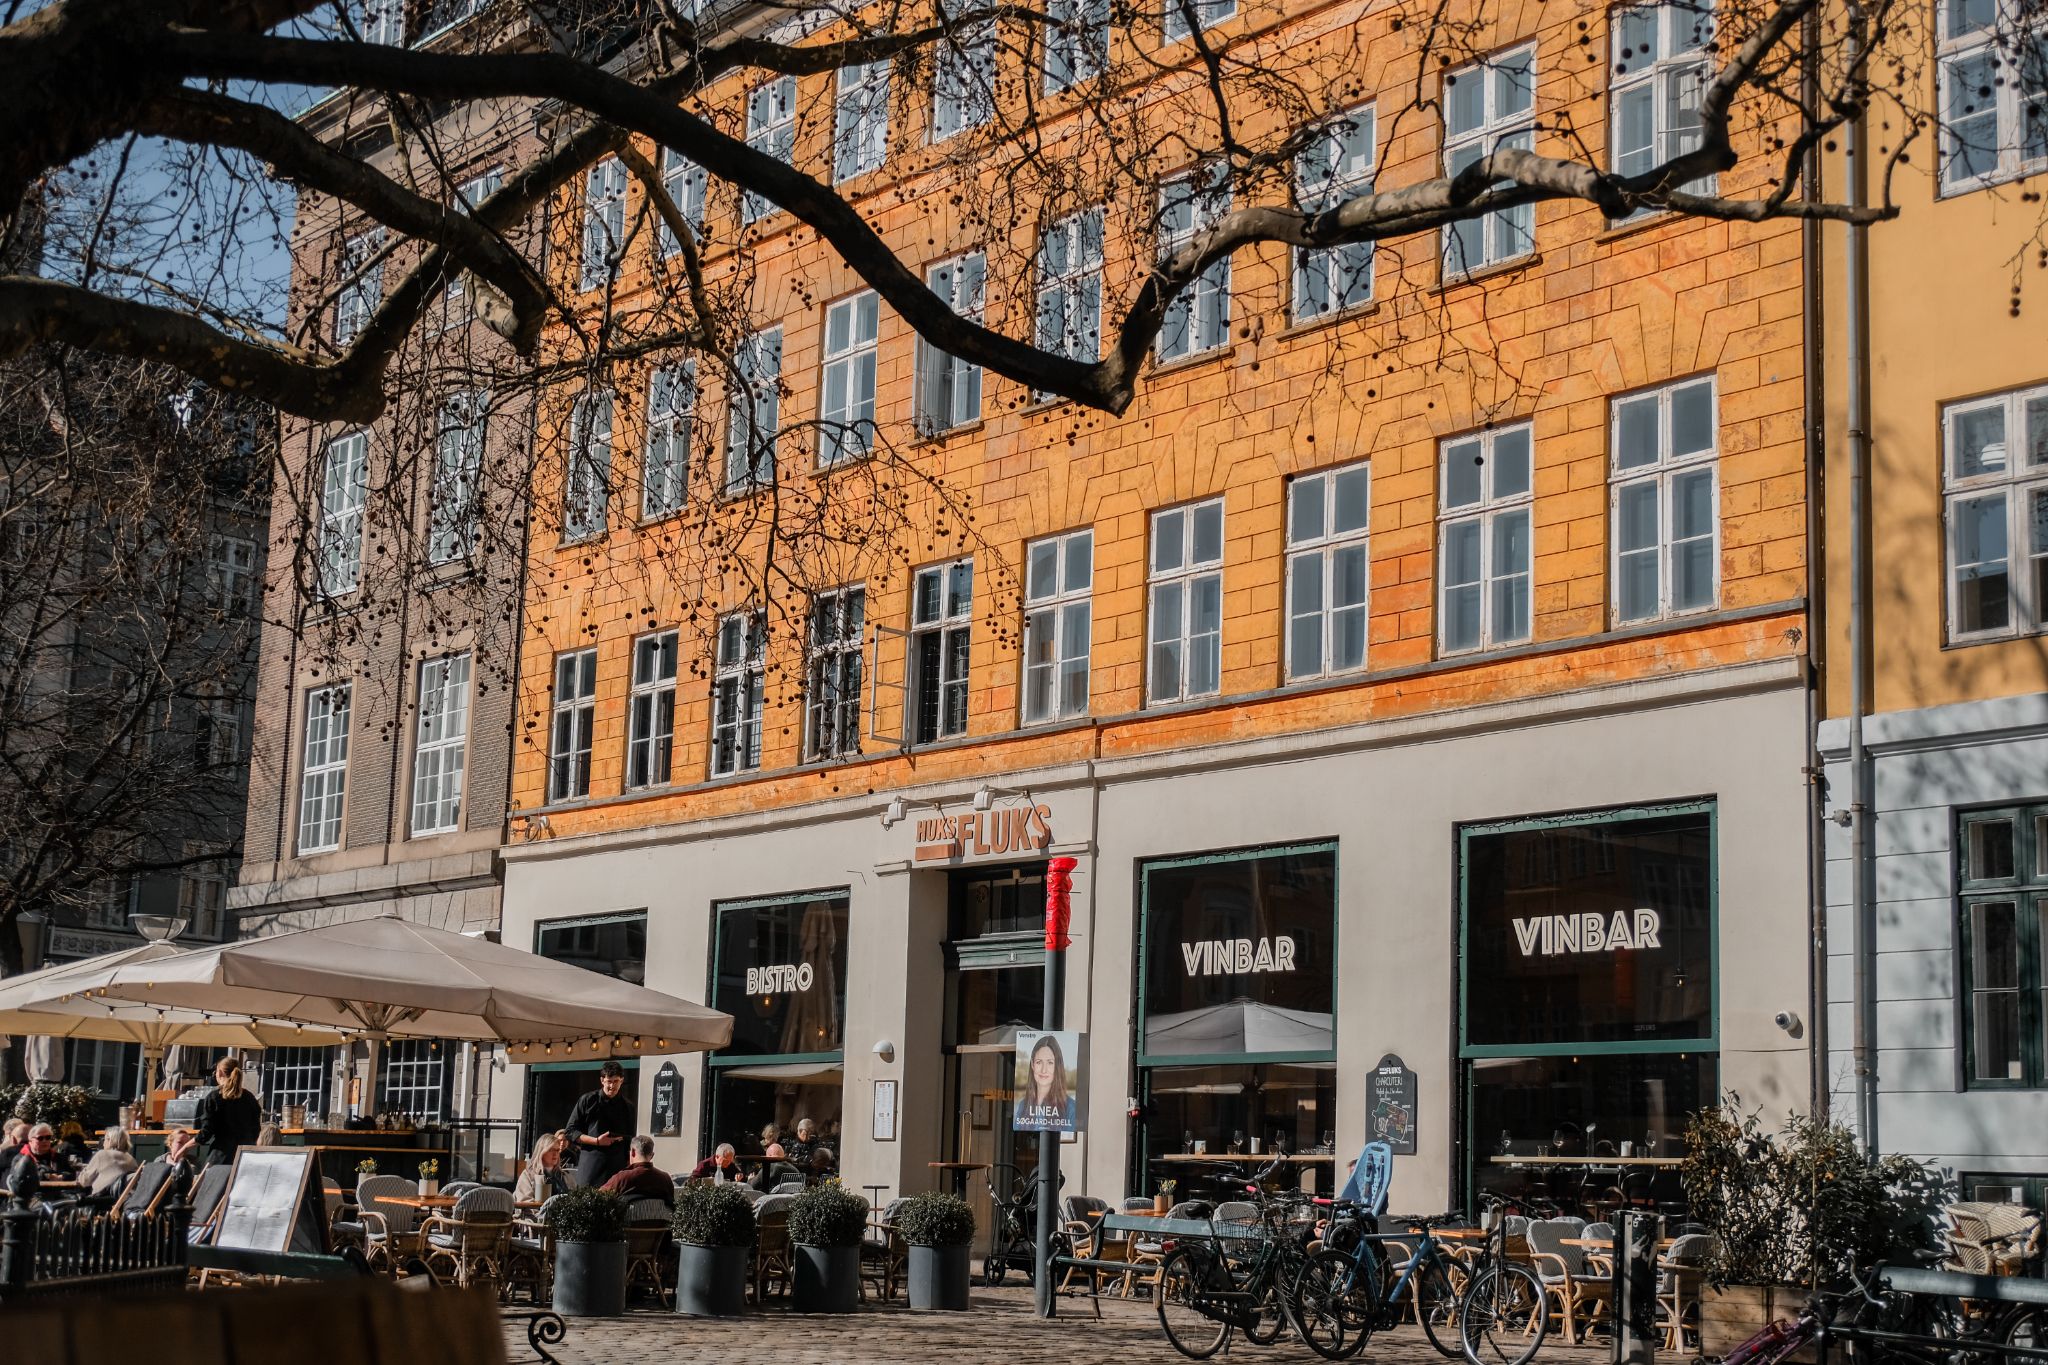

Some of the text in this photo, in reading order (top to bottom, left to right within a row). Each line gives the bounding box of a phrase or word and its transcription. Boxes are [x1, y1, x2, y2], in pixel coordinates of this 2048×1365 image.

[916, 804, 1052, 857] HUKS FLUKS
[1511, 908, 1661, 956] VINBAR
[1181, 935, 1296, 976] VINBAR
[746, 962, 813, 995] BISTRO
[1015, 1117, 1073, 1127] SØGAARD-LIDELL
[1029, 1105, 1060, 1117] LINEA
